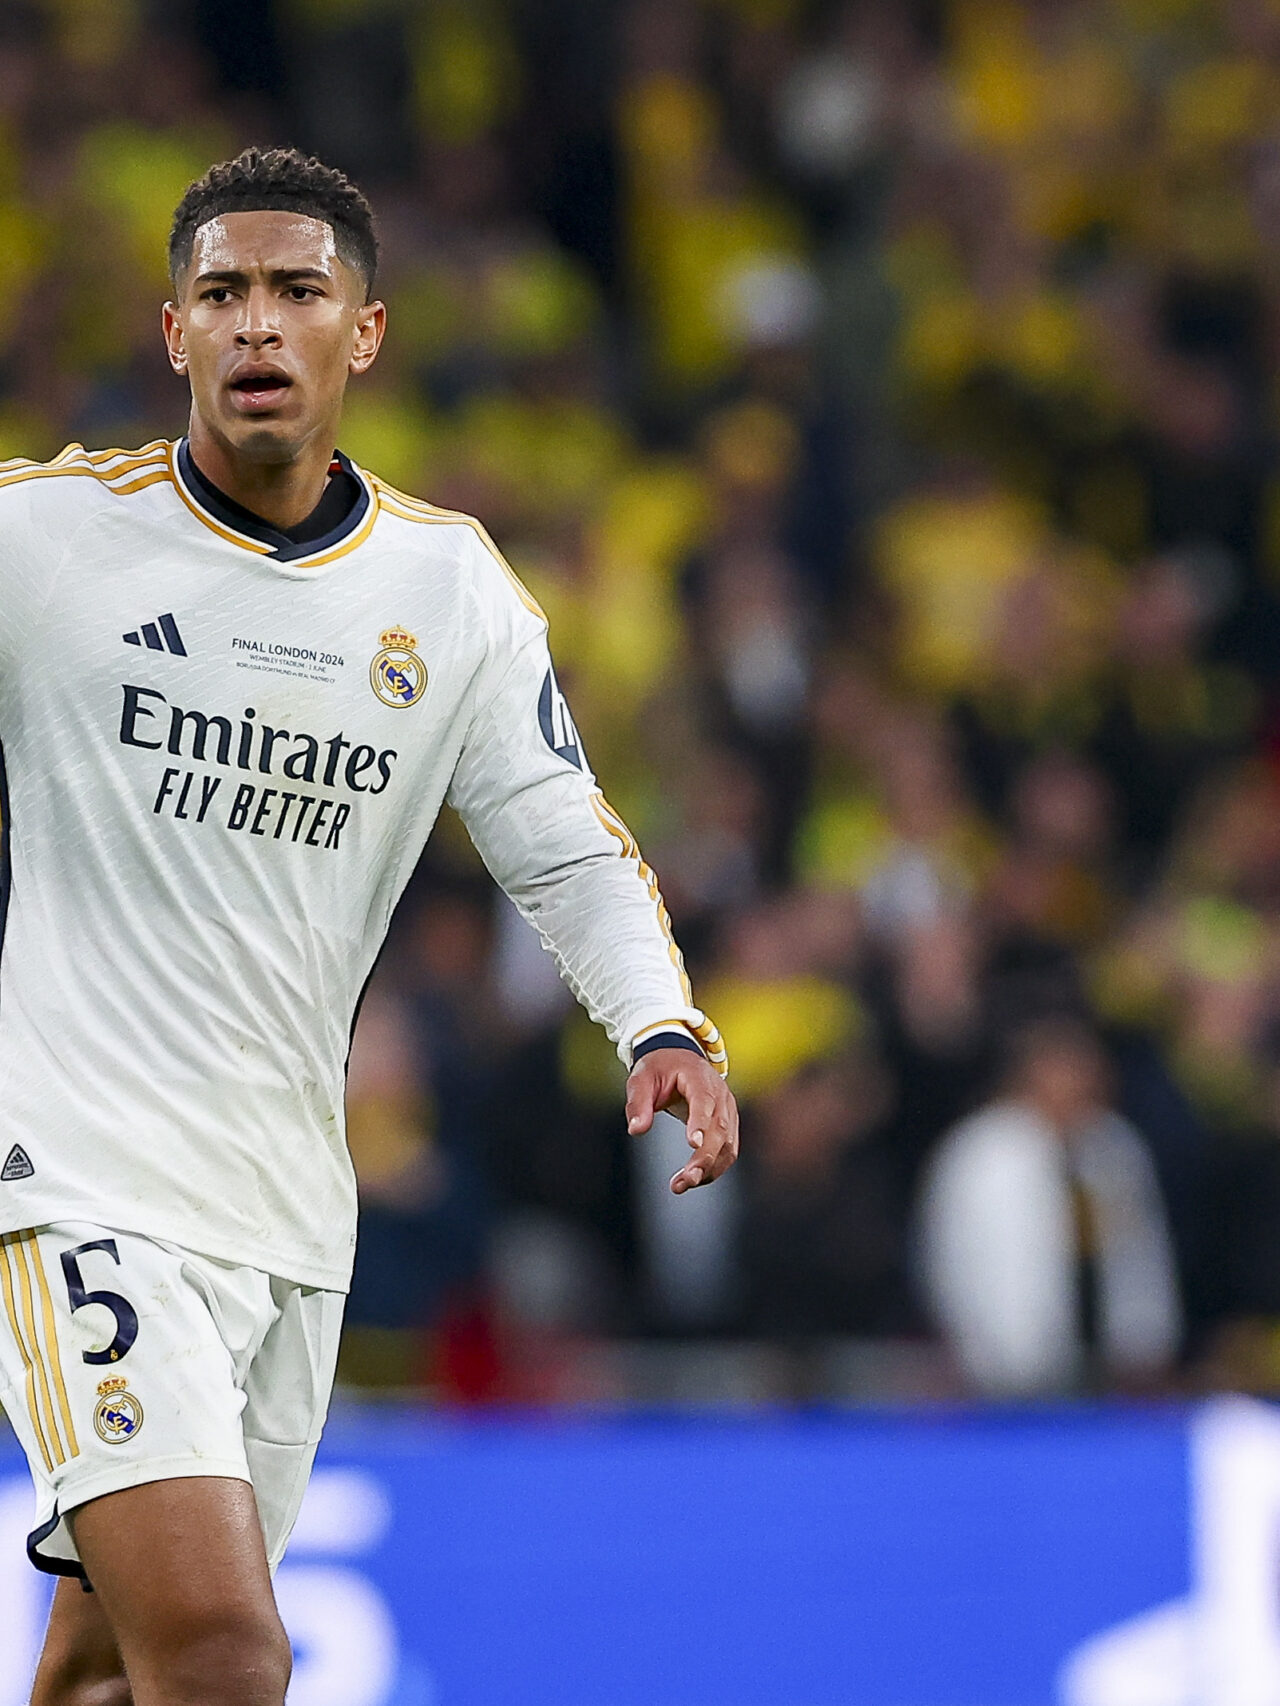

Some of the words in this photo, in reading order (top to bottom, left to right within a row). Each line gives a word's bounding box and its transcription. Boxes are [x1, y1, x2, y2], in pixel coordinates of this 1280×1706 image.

[231, 638, 266, 653] FINAL
[268, 643, 317, 661] LONDON
[319, 652, 345, 667] 2024
[120, 683, 398, 795] Emirates
[153, 767, 222, 823] FLY
[227, 783, 351, 850] BETTER
[60, 1238, 139, 1366] 5
